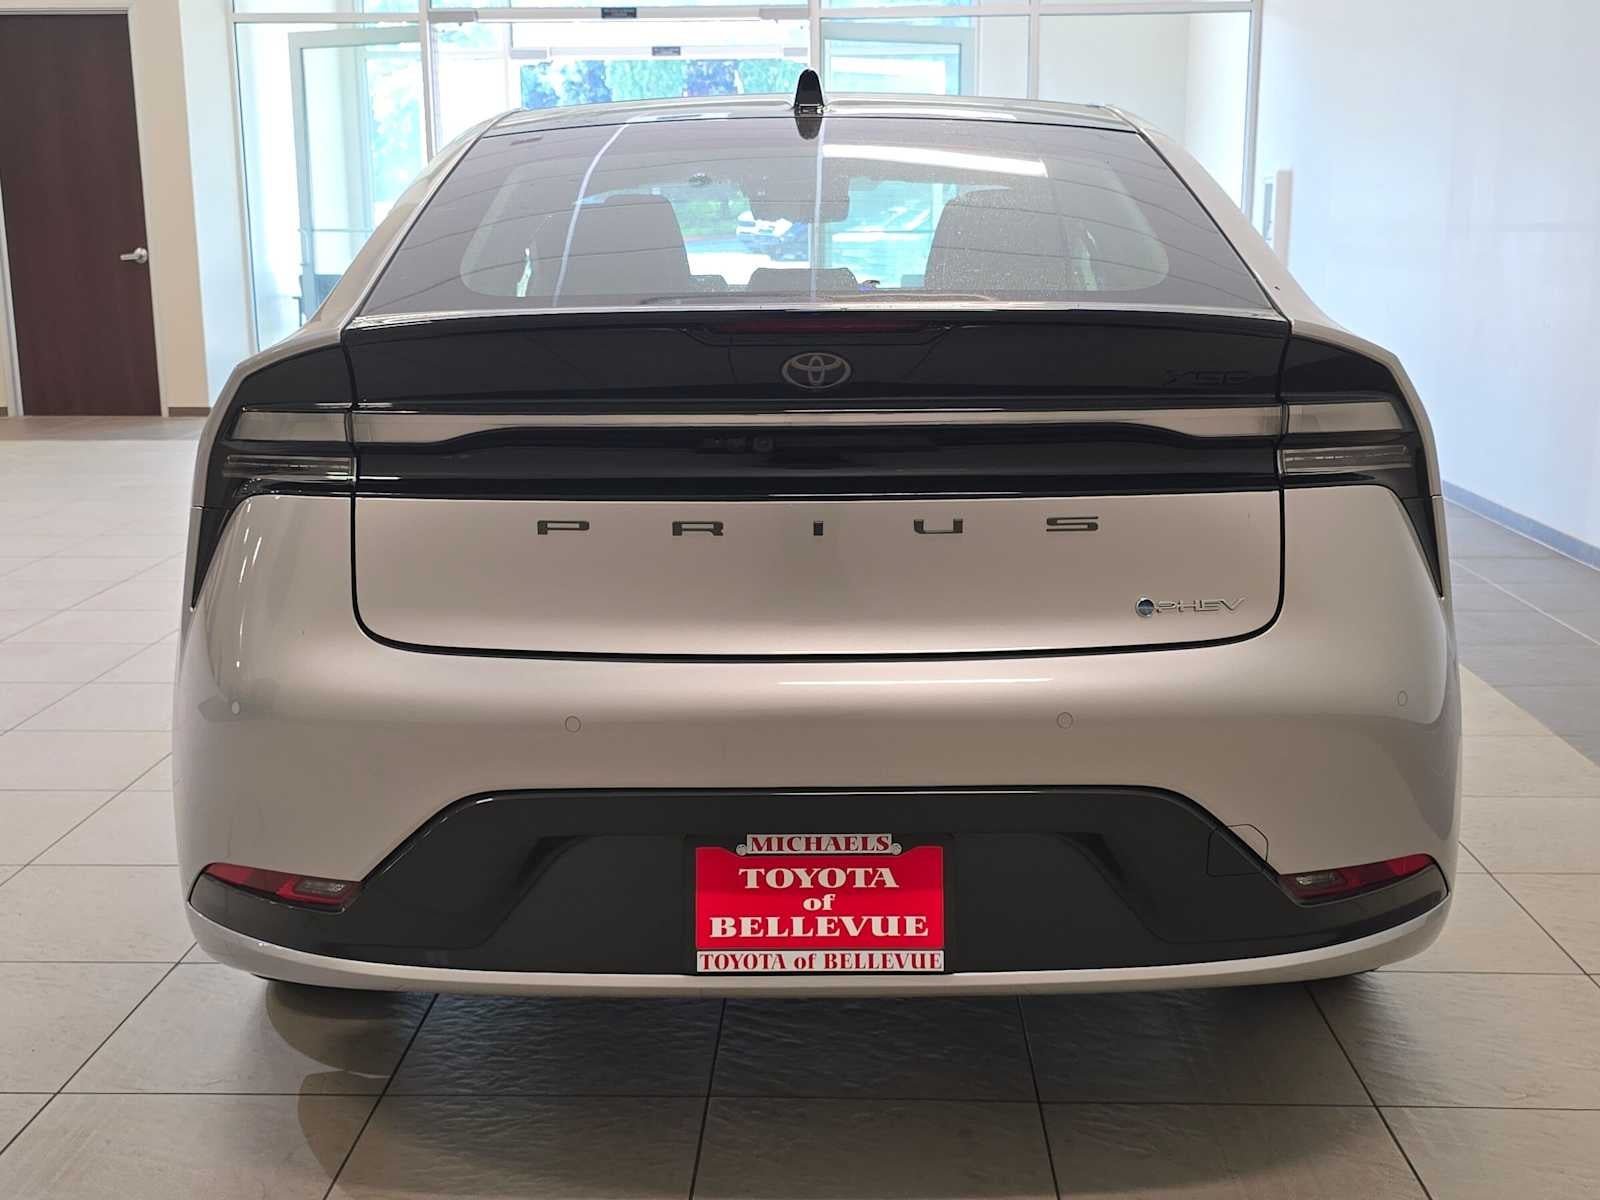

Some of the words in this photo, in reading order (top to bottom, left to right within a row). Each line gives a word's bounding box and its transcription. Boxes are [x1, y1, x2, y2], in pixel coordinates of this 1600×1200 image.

[537, 515, 1099, 537] PRIUS
[1155, 597, 1246, 614] PHEV
[750, 836, 891, 852] MICHAELS
[738, 867, 899, 889] TOYOTA
[802, 893, 836, 911] of
[709, 915, 929, 938] BELLEVUE
[700, 953, 786, 970] TOYOTA
[793, 953, 816, 970] of
[823, 953, 942, 970] BELLEVUE
